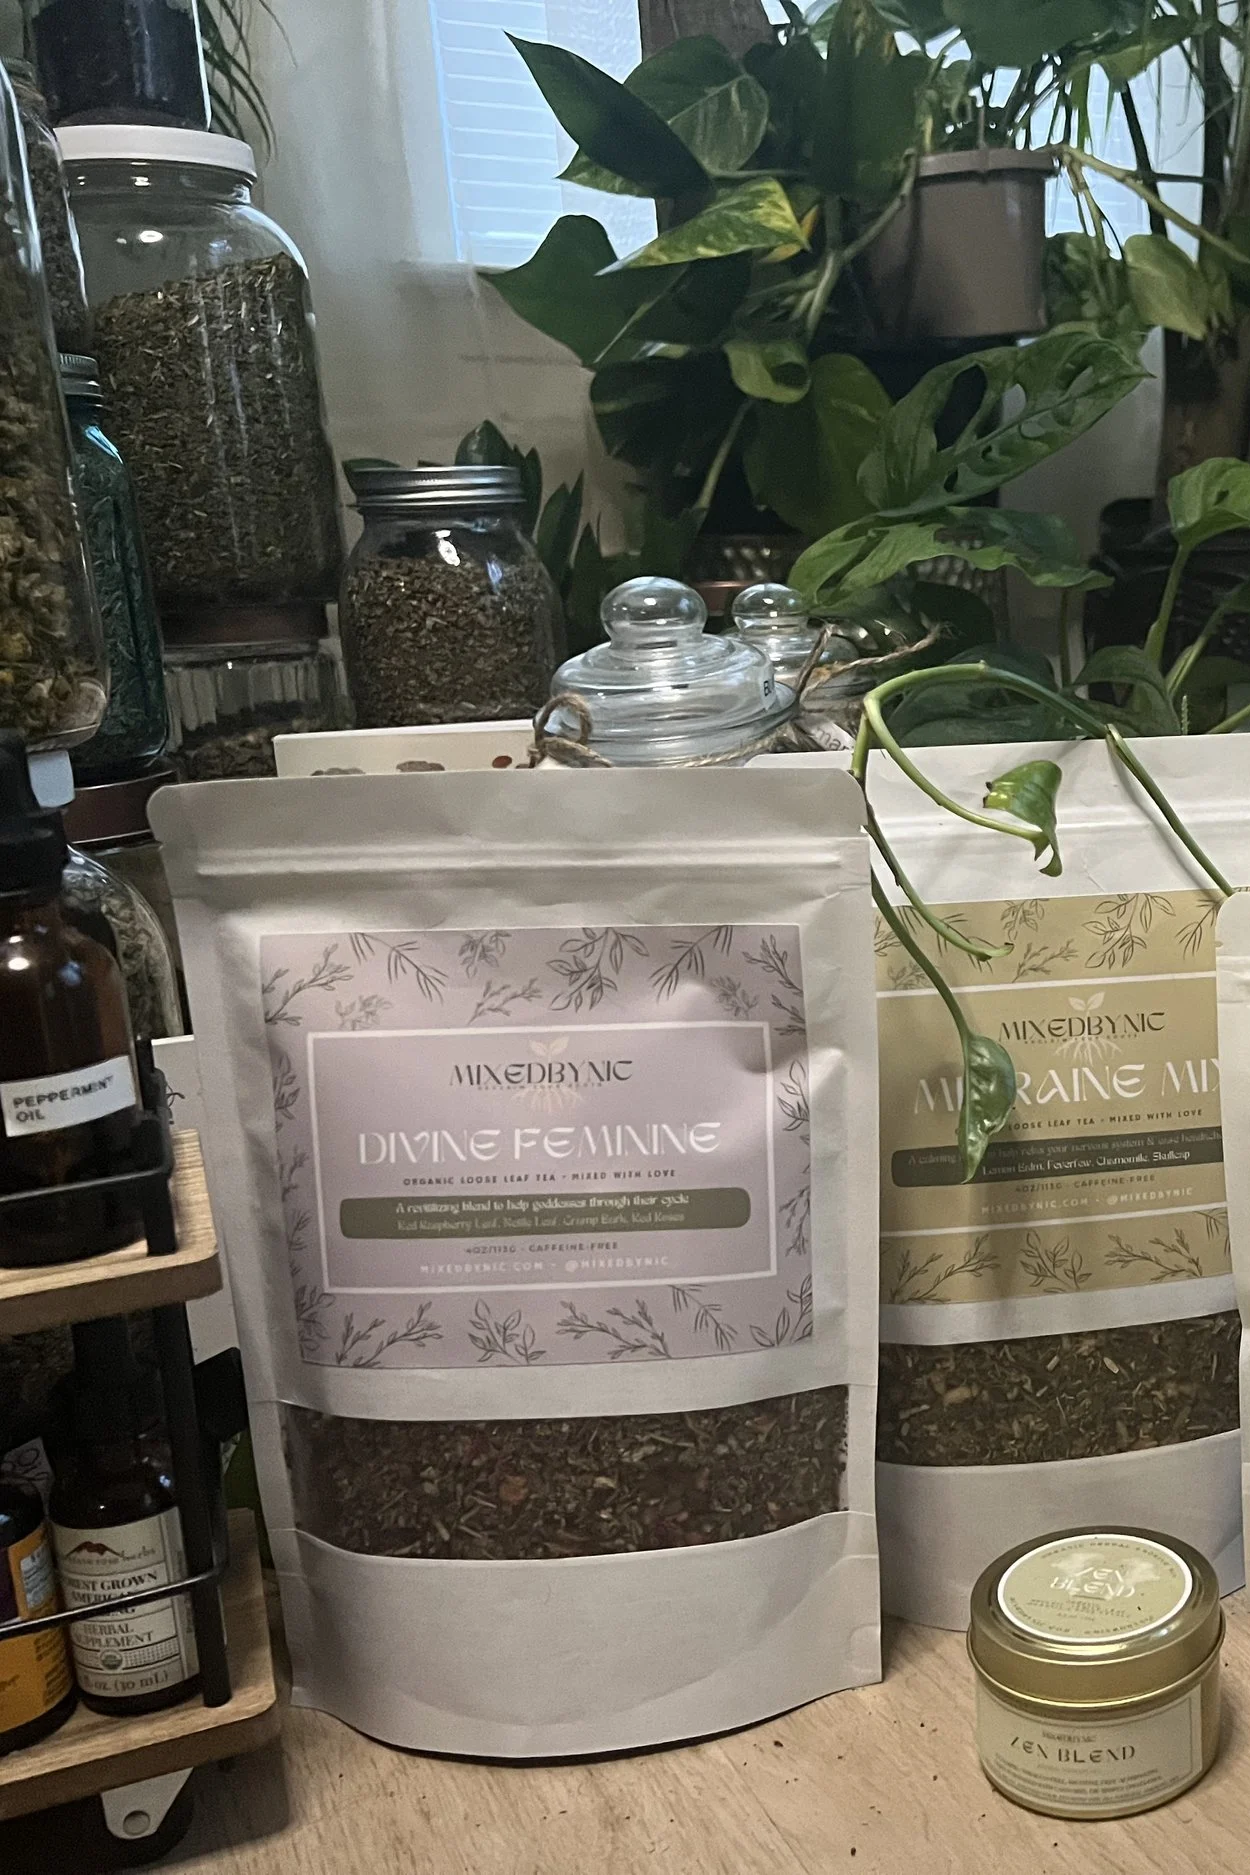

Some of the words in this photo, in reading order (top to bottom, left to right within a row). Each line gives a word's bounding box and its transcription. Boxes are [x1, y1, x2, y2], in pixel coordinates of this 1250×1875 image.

[999, 1012, 1165, 1041] MIXEDBYNIC
[450, 1060, 632, 1086] MIXEDBYNIC
[13, 1075, 114, 1108] PEPPERMINT
[915, 1064, 1146, 1114] MIRAINE
[16, 1109, 45, 1122] OIL
[1008, 1121, 1042, 1131] LOOSE
[1048, 1119, 1071, 1128] LEAF
[1077, 1118, 1095, 1127] TEA
[1109, 1114, 1141, 1123] MIXED
[1147, 1111, 1172, 1120] WITH
[1178, 1109, 1203, 1118] LOVE
[359, 1129, 501, 1165] DIVINE
[514, 1122, 721, 1160] FEMININE
[1152, 1150, 1191, 1163] Skullcap
[403, 1177, 454, 1186] ORGANIC
[460, 1175, 497, 1184] LOOSE
[503, 1174, 529, 1183] LEAF
[536, 1174, 556, 1182] TEA
[572, 1172, 607, 1180] MIXED
[613, 1171, 641, 1179] WITH
[647, 1169, 675, 1178] LOVE
[1074, 1174, 1156, 1189] CAFFEINE-FREE
[462, 1200, 491, 1212] blend
[493, 1200, 504, 1211] to
[506, 1199, 529, 1213] help
[589, 1195, 630, 1209] through
[633, 1194, 656, 1206] their
[1107, 1187, 1193, 1205] @MIXEDBYNIC
[101, 1573, 158, 1590] GROWN
[1050, 1576, 1136, 1598] BLEND
[83, 1623, 135, 1635] HERBAL
[1058, 1745, 1135, 1763] BLEND
